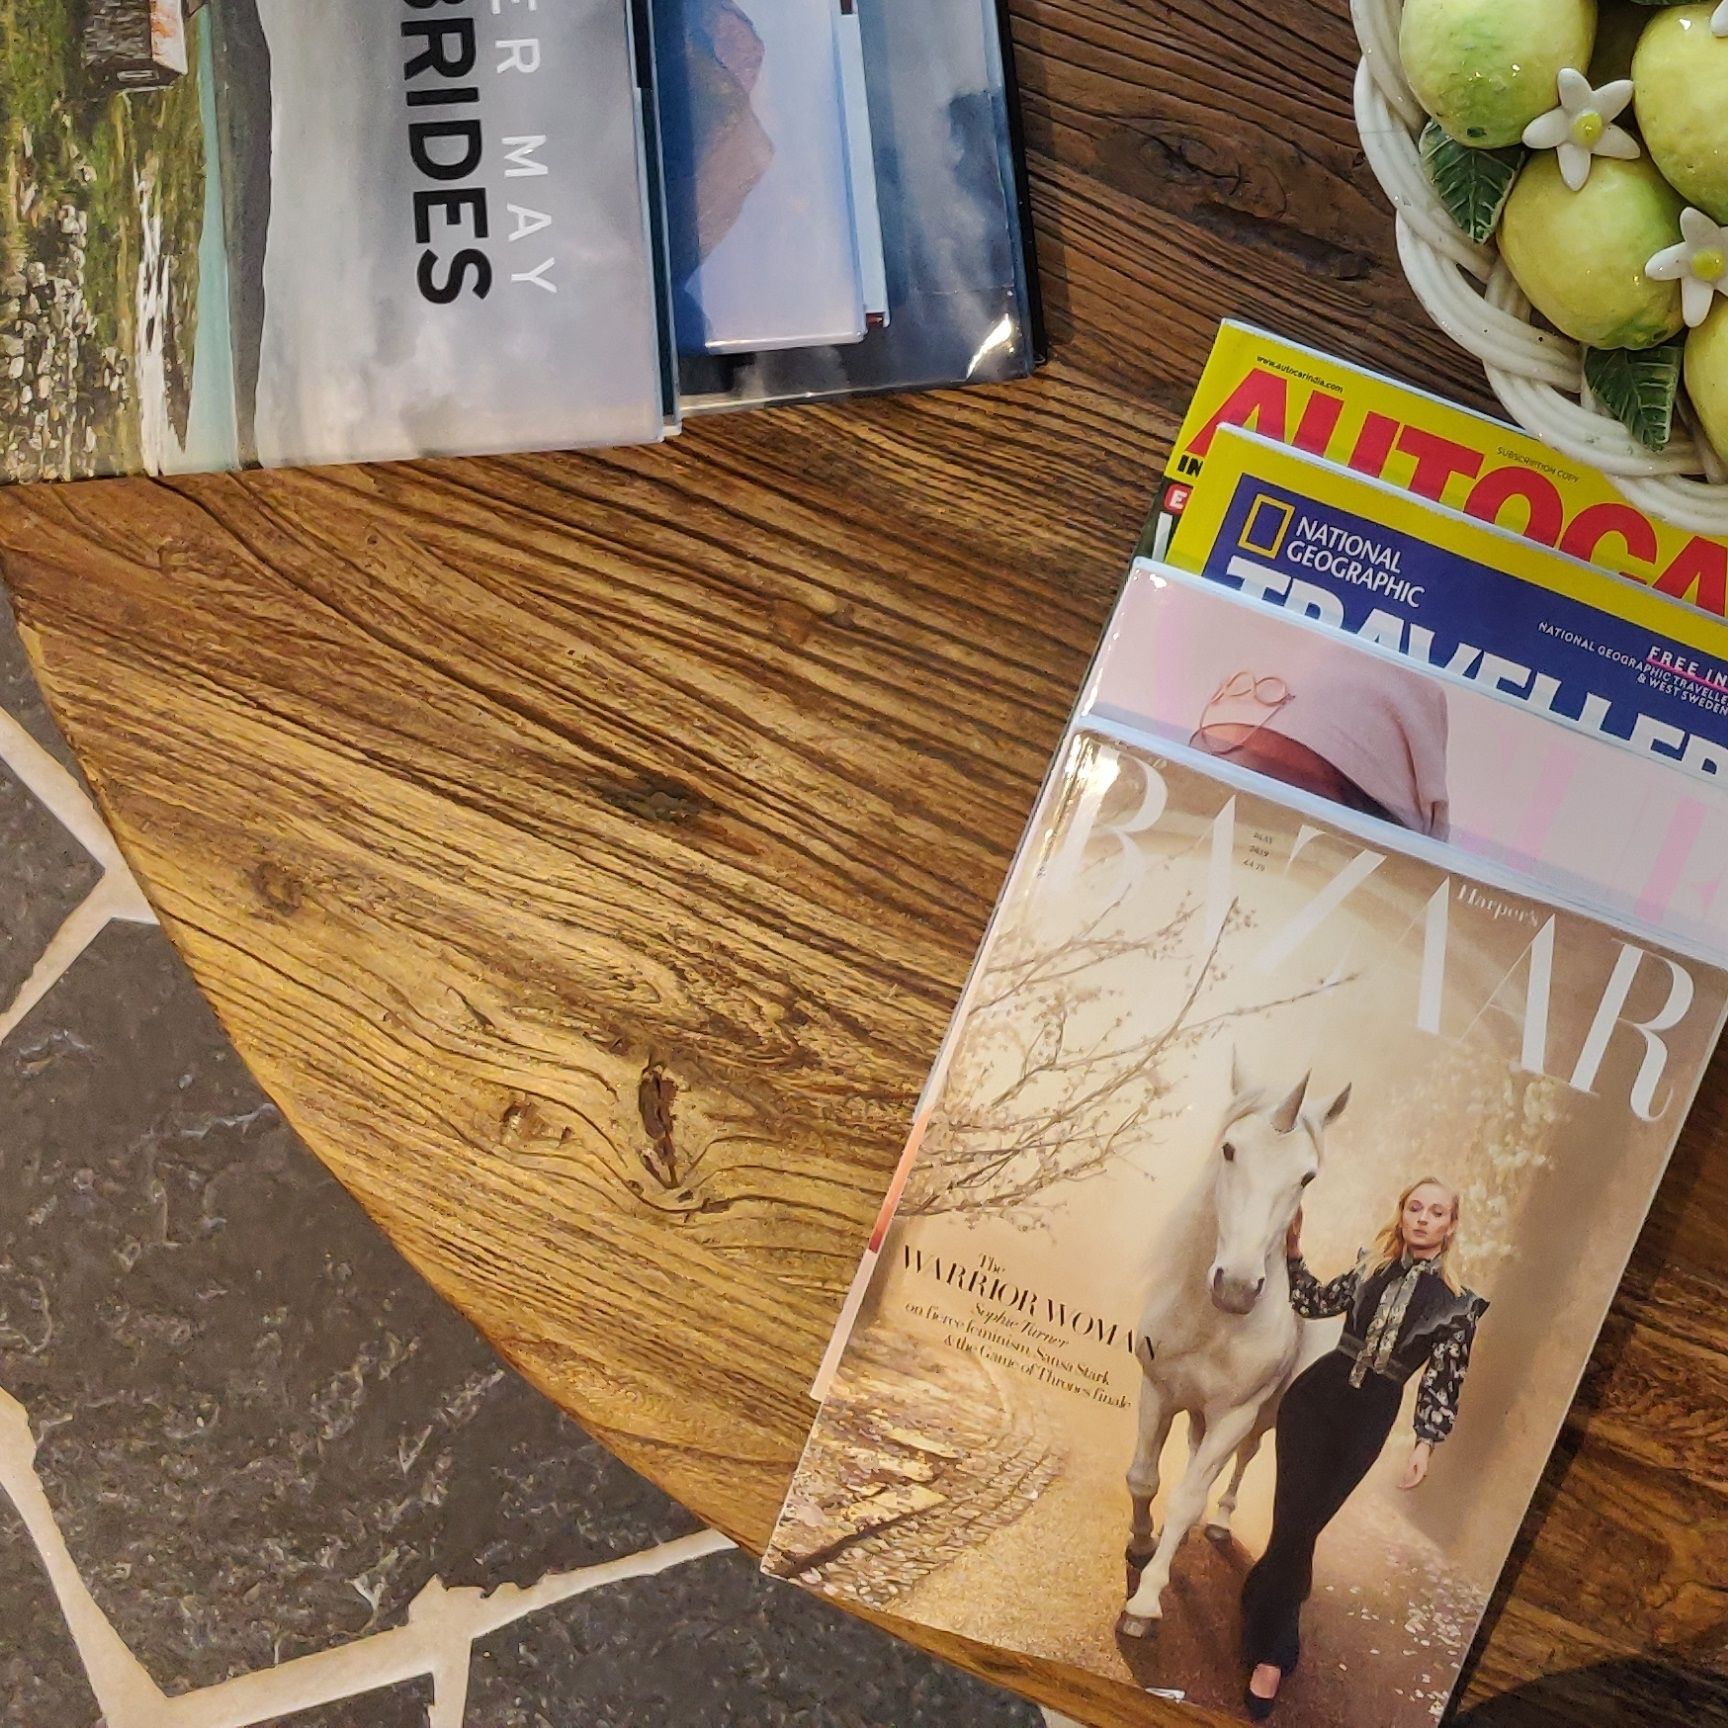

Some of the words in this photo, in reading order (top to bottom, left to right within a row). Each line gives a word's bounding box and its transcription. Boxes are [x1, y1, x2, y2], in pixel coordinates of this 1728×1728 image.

[500, 134, 557, 293] MAY
[1285, 538, 1425, 608] GEOGRAPHIC
[1295, 515, 1405, 573] NATIONAL
[1537, 621, 1596, 651] NATIONAL
[1596, 644, 1671, 682] GEOGRAPHIC
[1647, 645, 1700, 676] FREE
[1647, 677, 1679, 697] WEST
[1680, 691, 1728, 716] SWEDEN
[1040, 741, 1695, 1122] BAZAAR
[974, 1252, 1007, 1277] The
[905, 1245, 1040, 1316] WARRIOR
[1048, 1297, 1161, 1361] WOMAN
[970, 1300, 1021, 1330] Sophie
[1018, 1319, 1070, 1350] Turner
[904, 1301, 923, 1316] on
[925, 1305, 967, 1331] fierce
[1033, 1347, 1075, 1372] Sansa
[1074, 1362, 1113, 1385] Stark
[954, 1334, 980, 1355] the
[978, 1343, 1019, 1370] Game
[1036, 1366, 1092, 1397] Thrones
[1091, 1385, 1131, 1411] finale
